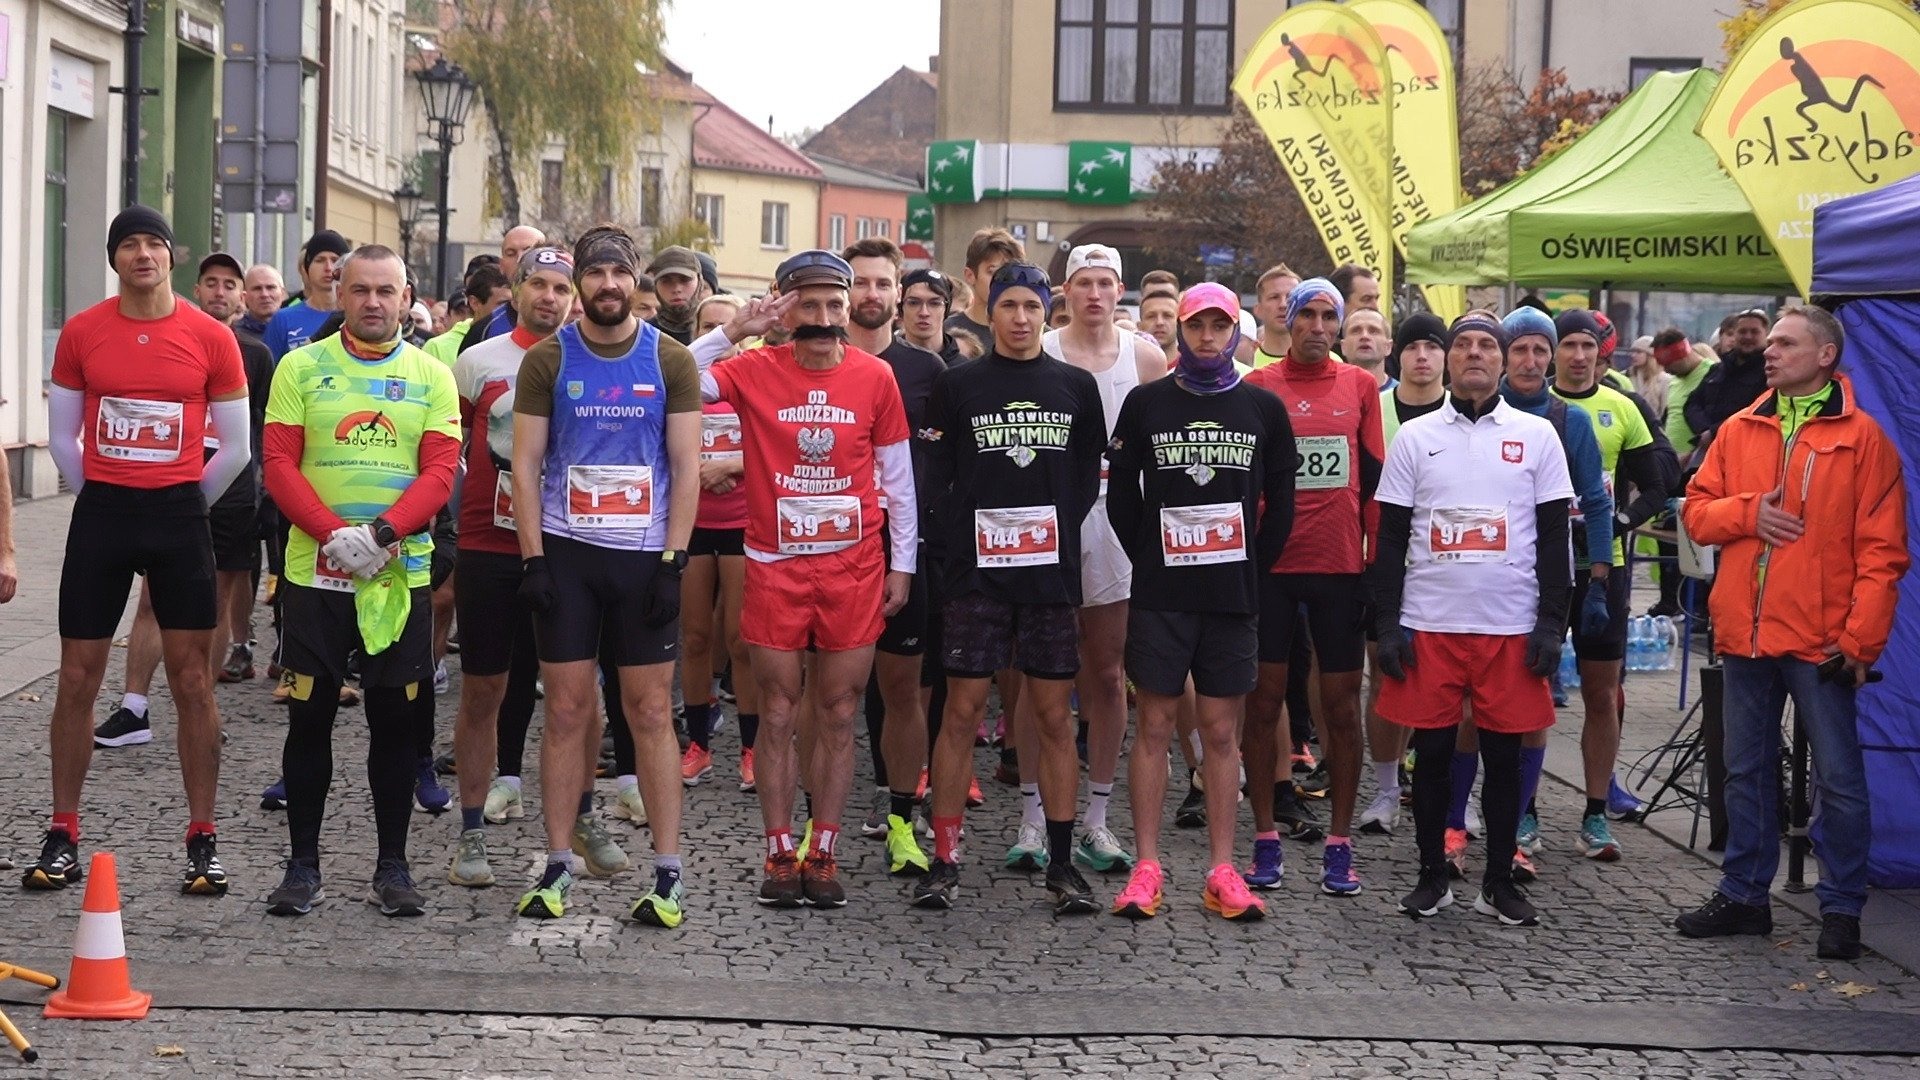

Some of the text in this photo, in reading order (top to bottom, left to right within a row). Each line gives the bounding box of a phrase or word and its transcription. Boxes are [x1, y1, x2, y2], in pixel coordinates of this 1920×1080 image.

[1541, 233, 1727, 263] OŚWIĘCIMSKI
[807, 389, 828, 405] OD
[574, 405, 646, 418] WITKOWO
[777, 404, 857, 424] URODZENIA
[970, 413, 1004, 428] UNIA
[104, 417, 142, 441] 197
[700, 429, 715, 447] 9
[974, 426, 1070, 449] SWIMMING
[1151, 431, 1184, 445] UNIA
[335, 430, 398, 452] zadyszka
[1154, 445, 1254, 467] SWIMMING
[1296, 451, 1340, 477] 282
[774, 471, 852, 494] Z POCHODZENIA
[793, 464, 836, 478] DUMNI
[588, 484, 599, 508] 1
[789, 514, 819, 537] 39
[1167, 524, 1208, 548] 160
[1440, 522, 1464, 546] 97
[982, 526, 1021, 549] 144
